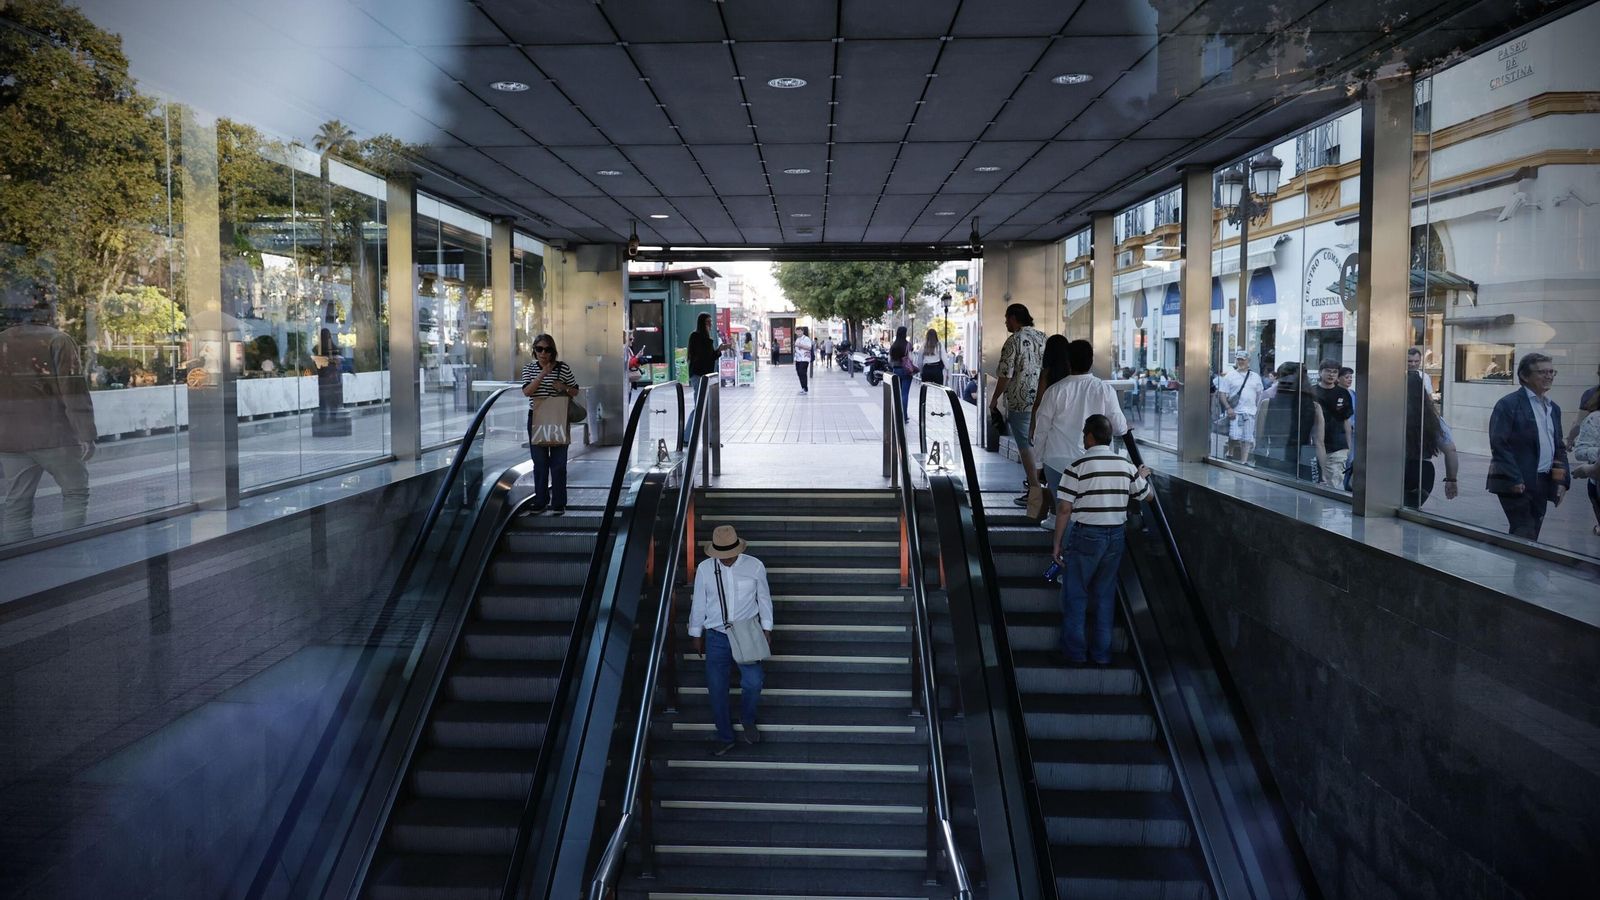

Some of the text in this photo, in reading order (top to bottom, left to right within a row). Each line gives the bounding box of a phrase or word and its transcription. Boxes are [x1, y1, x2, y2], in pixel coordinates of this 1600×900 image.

[1497, 39, 1528, 60] PASEO
[1505, 56, 1518, 70] DE
[1489, 64, 1534, 88] CRISTINA
[1305, 258, 1320, 303] CENTRO
[1311, 295, 1341, 307] CRISTINA
[531, 424, 567, 442] ZARA
